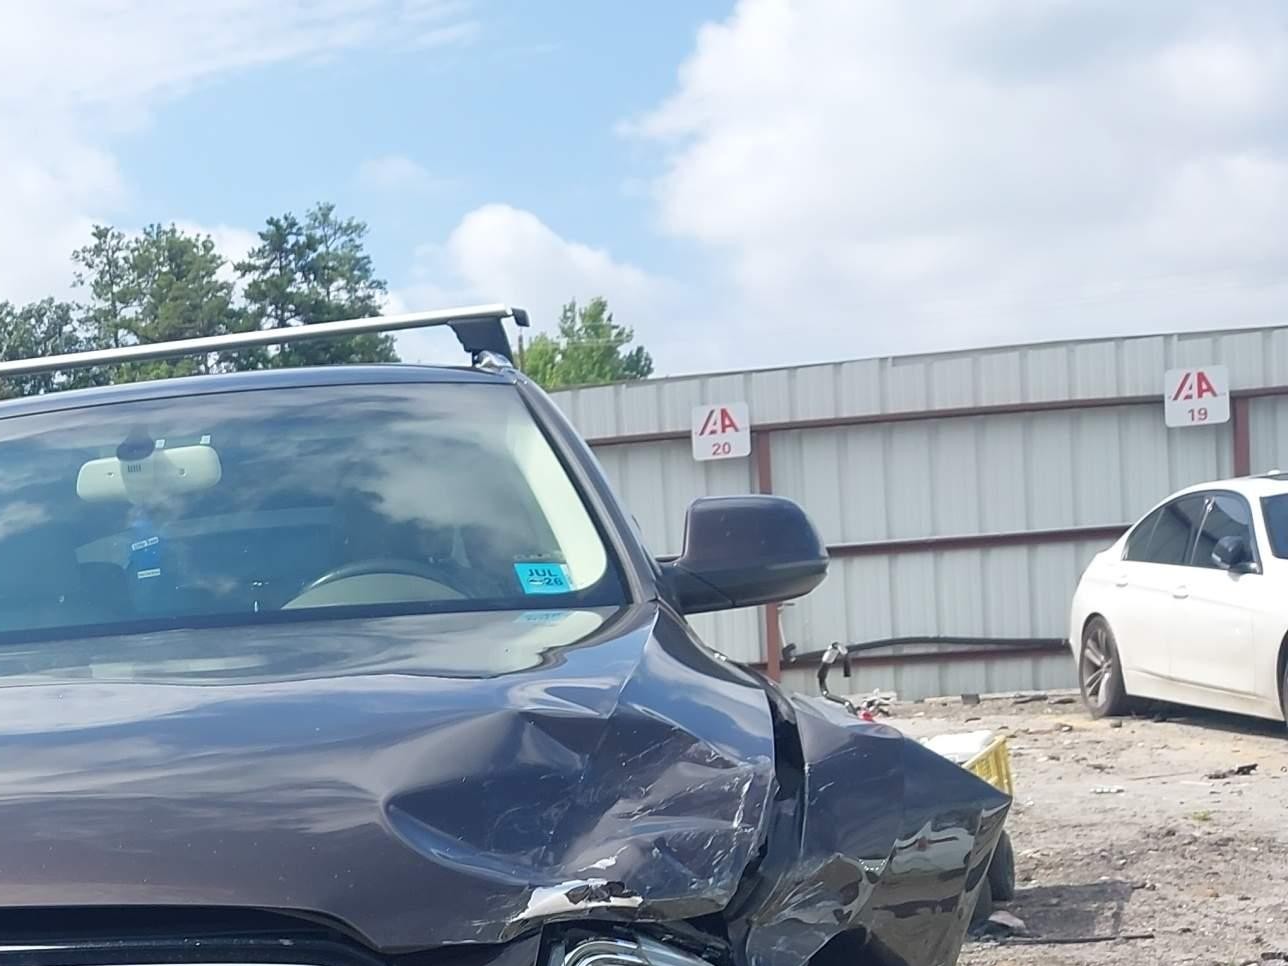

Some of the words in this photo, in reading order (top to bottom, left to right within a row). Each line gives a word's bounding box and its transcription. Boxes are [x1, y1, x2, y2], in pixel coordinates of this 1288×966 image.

[1187, 407, 1208, 421] 19
[712, 441, 731, 456] 20
[528, 568, 558, 577] JUL
